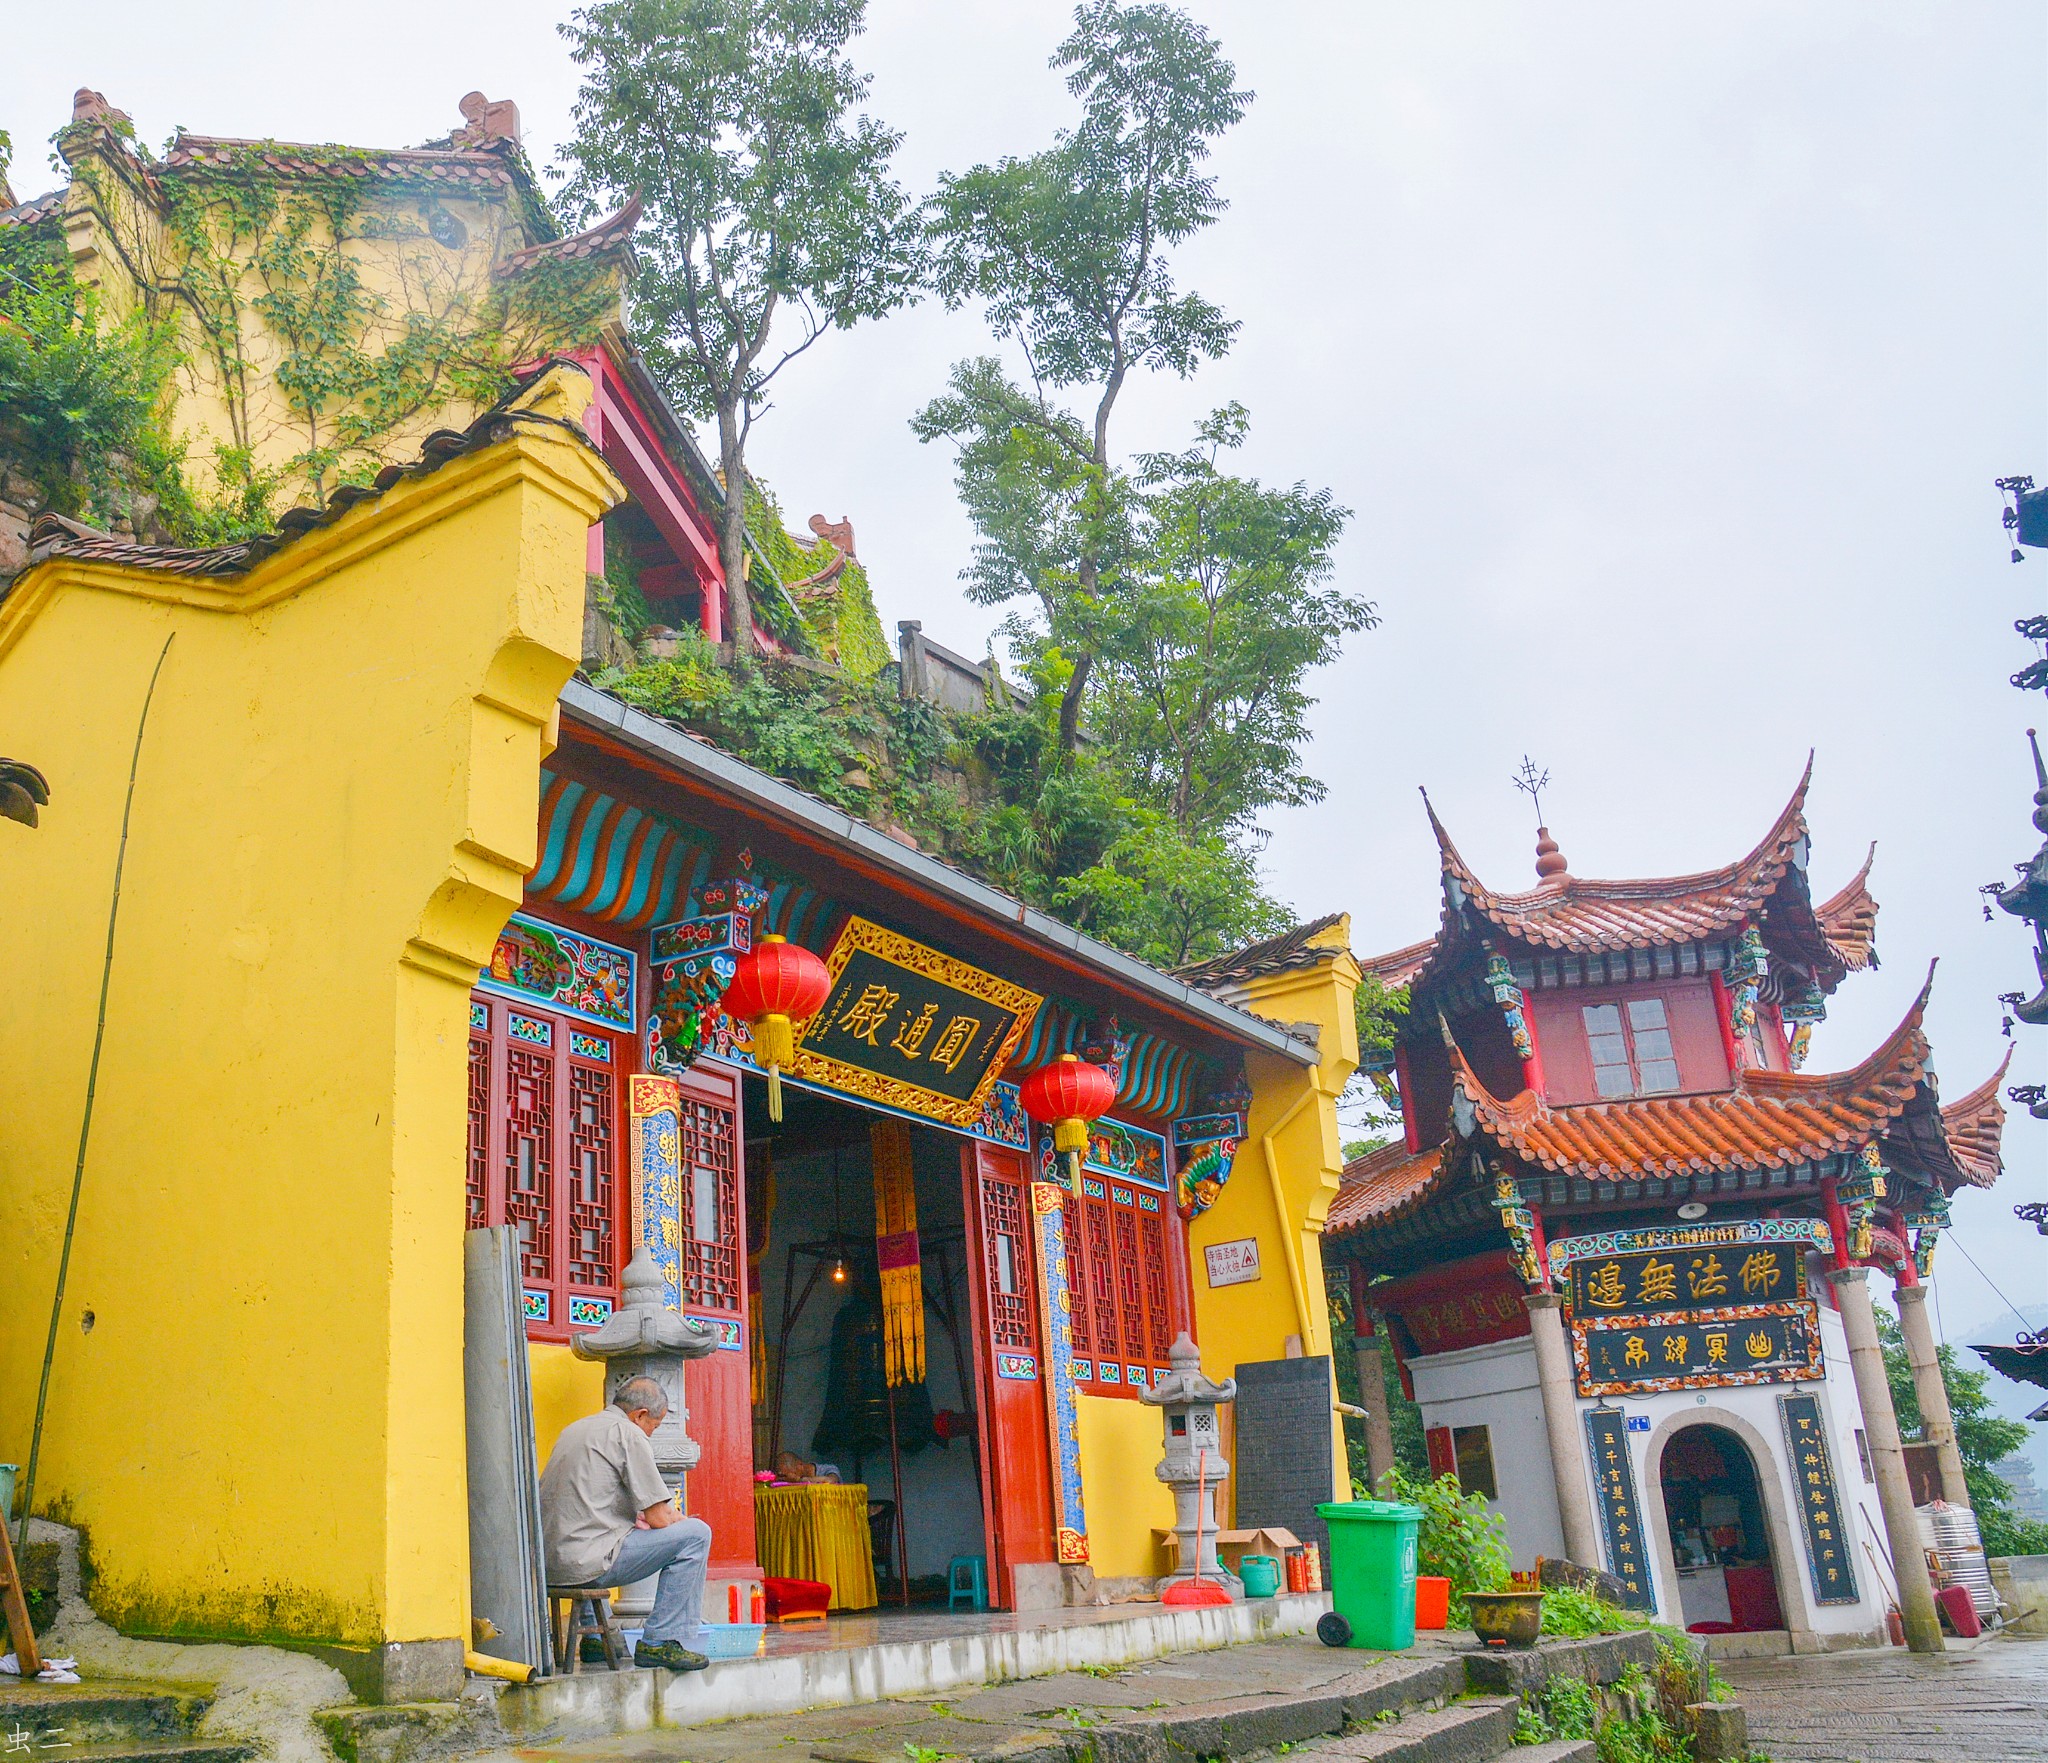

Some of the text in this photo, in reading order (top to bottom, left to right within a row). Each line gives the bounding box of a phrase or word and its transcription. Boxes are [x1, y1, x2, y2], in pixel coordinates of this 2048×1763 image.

[837, 983, 981, 1075] 圓通殿
[1210, 1260, 1241, 1277] 当心火烛
[1588, 1249, 1781, 1308] 佛法無邊
